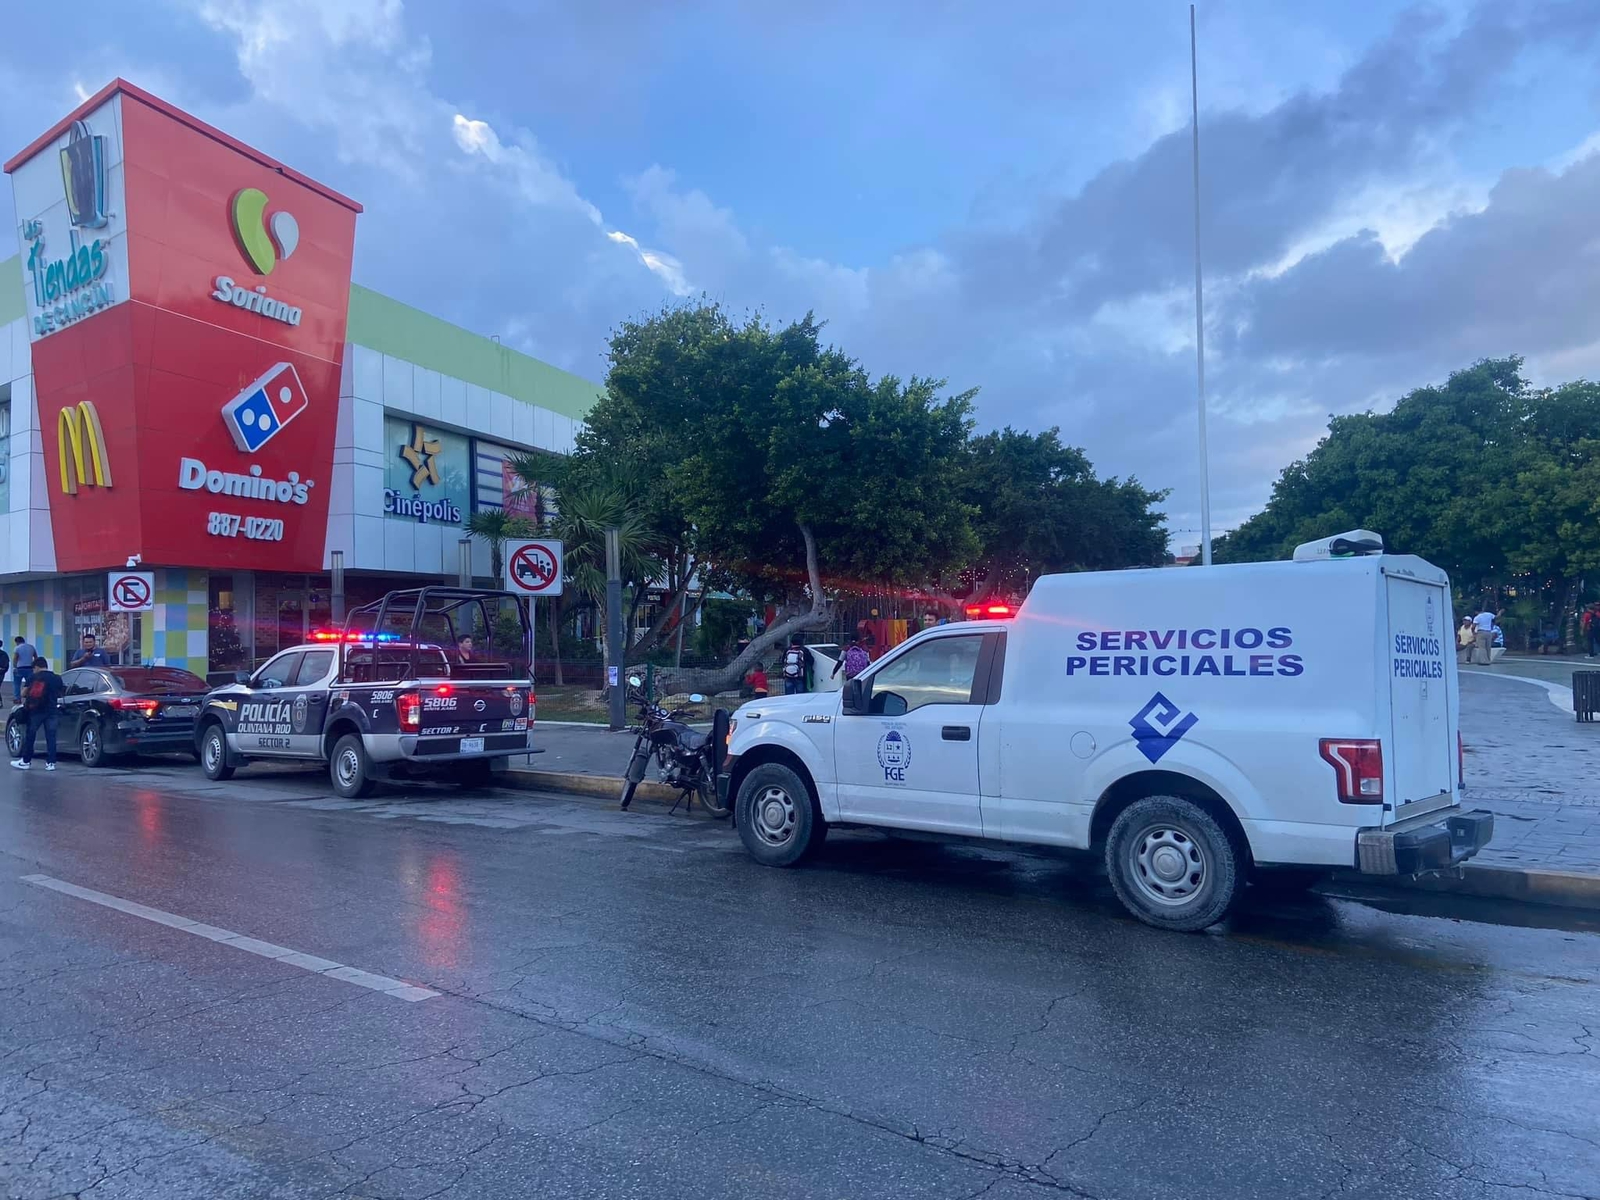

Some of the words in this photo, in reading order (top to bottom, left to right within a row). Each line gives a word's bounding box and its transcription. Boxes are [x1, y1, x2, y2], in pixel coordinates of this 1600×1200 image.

[27, 230, 108, 308] Tiendas
[211, 275, 303, 327] Soriana
[34, 312, 56, 336] DE
[178, 456, 310, 505] Domino's
[383, 486, 462, 523] Cinépolis
[206, 511, 285, 541] 887-0220
[1075, 626, 1293, 651] SERVICIOS
[1394, 634, 1440, 657] SERVICIOS
[1065, 654, 1305, 677] PERICIALES
[1393, 658, 1443, 679] PERICIALES
[370, 690, 395, 700] 5806
[423, 697, 458, 708] 5806
[239, 699, 291, 722] POLICÍA
[237, 723, 273, 733] QUINTANA
[274, 724, 291, 734] ROO
[420, 727, 453, 735] SECTOR
[452, 726, 460, 734] 2
[258, 737, 284, 749] SECTOR
[285, 738, 291, 748] 2
[884, 766, 906, 781] FGE
